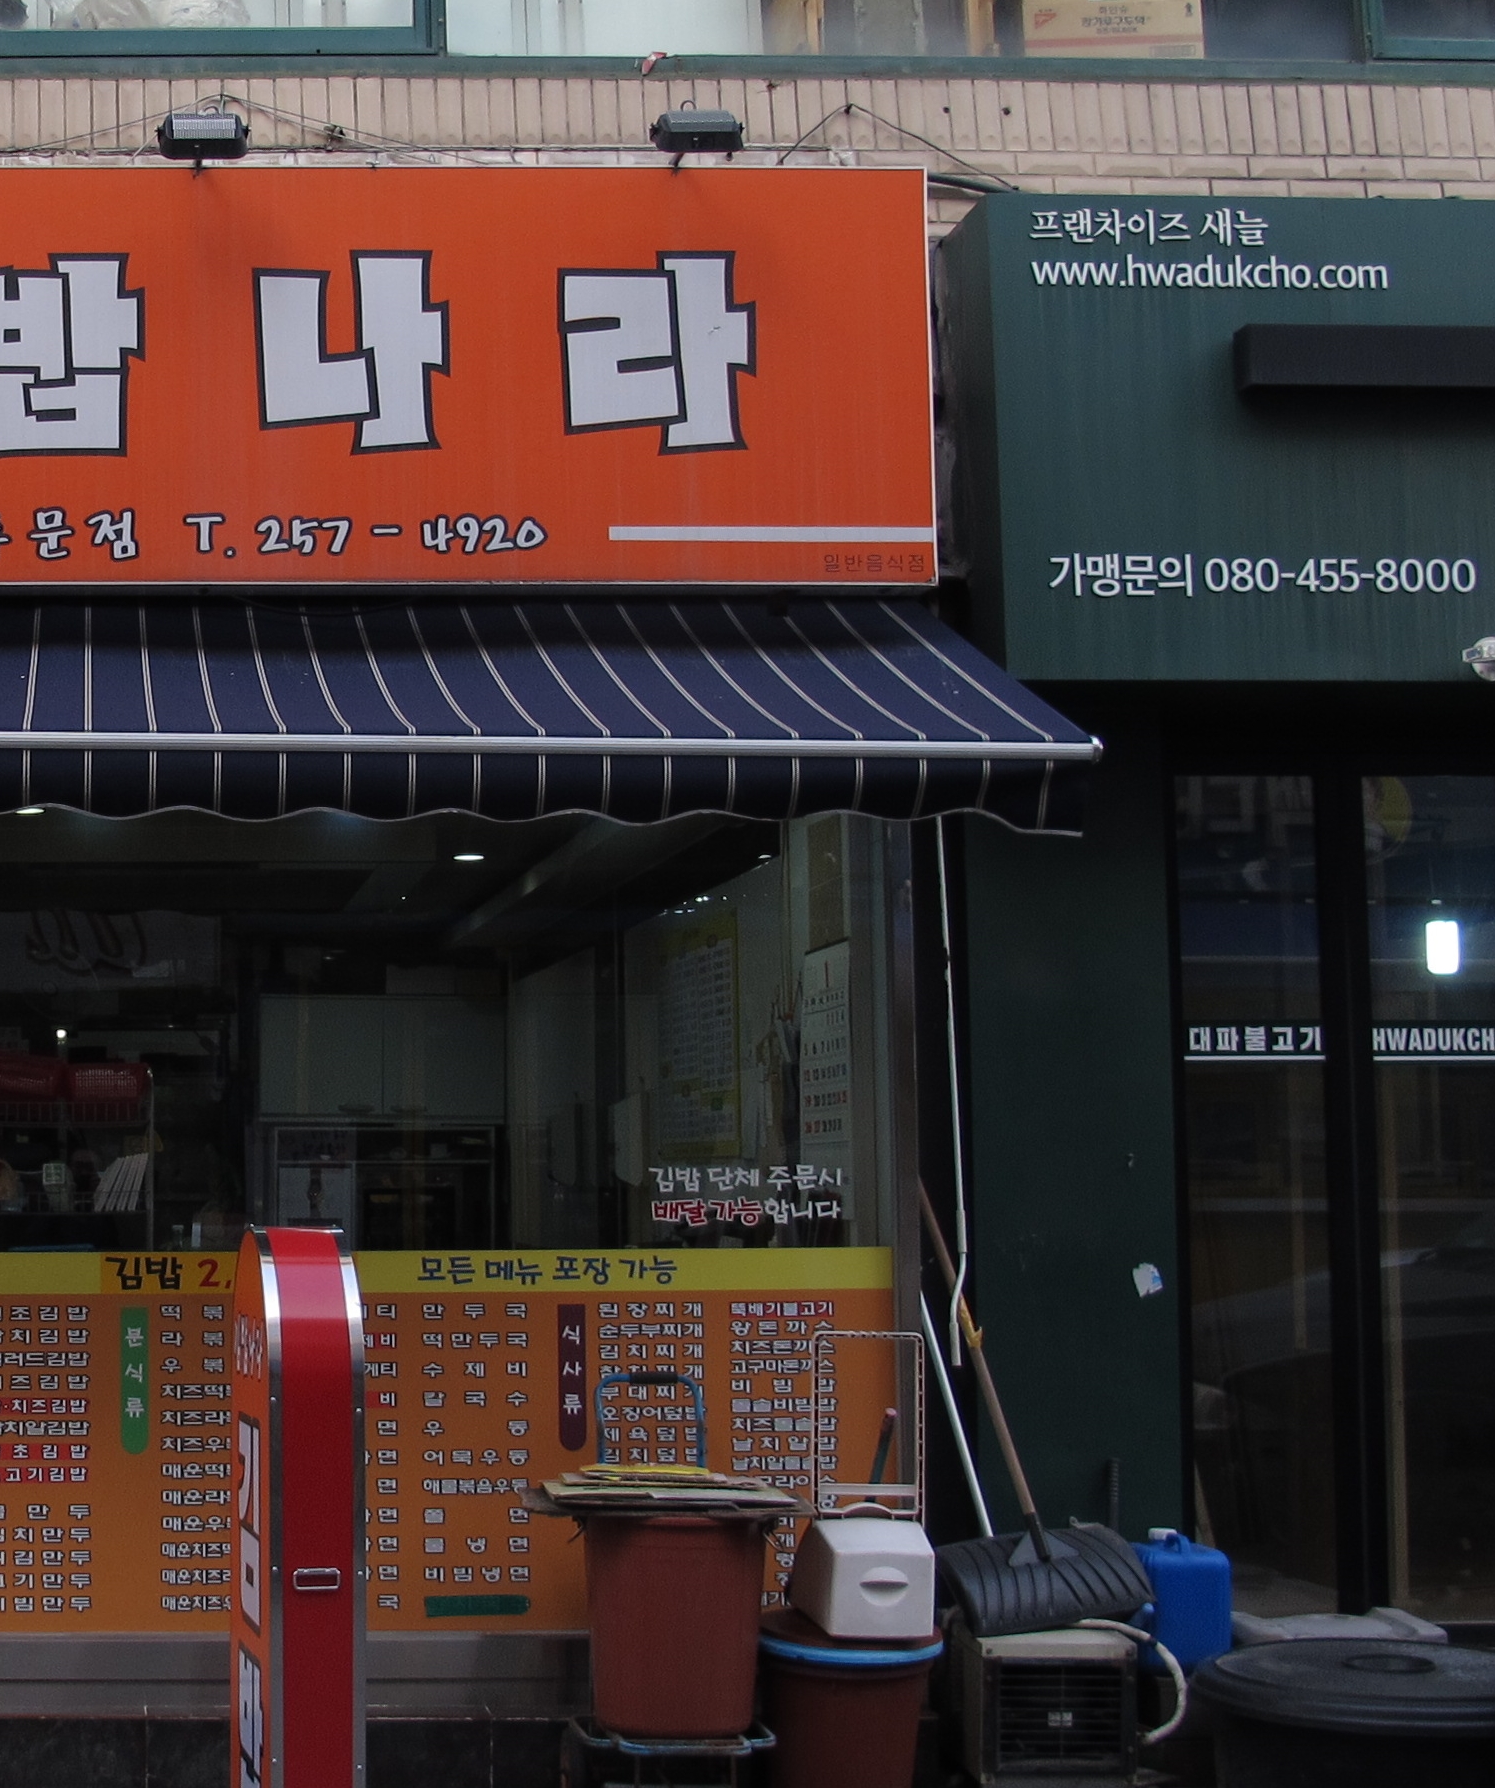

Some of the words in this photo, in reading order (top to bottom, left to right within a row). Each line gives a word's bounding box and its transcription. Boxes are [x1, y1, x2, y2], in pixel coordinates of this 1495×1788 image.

[1029, 208, 1192, 245] 프랜차이즈
[1200, 208, 1269, 247] 새늘
[1031, 255, 1388, 290] www.hwadukcho.com
[823, 552, 925, 574] 일반음식점
[1049, 553, 1194, 597] 가맹문의
[1204, 558, 1477, 594] 080-455-8000
[1188, 1026, 1322, 1052] 대파불고기
[648, 1166, 701, 1194] 김밥
[707, 1165, 760, 1192] 단체
[766, 1164, 843, 1189] 주문시
[651, 1199, 707, 1228] 배달
[708, 1195, 842, 1227] 가능합니다
[105, 1256, 183, 1291] 김밥
[417, 1256, 476, 1285] 모든
[484, 1256, 544, 1286] 메뉴
[552, 1255, 611, 1286] 포장
[618, 1254, 678, 1285] 가능
[423, 1303, 527, 1319] 만두국
[599, 1303, 703, 1318] 된장찌개
[423, 1333, 527, 1349] 떡만두국
[599, 1323, 703, 1339] 순두부찌개
[599, 1344, 703, 1359] 김치찌개
[124, 1327, 146, 1418] 분식류
[423, 1362, 527, 1378] 수제비
[561, 1323, 583, 1415] 식사류
[423, 1391, 527, 1407] 칼국수
[423, 1449, 527, 1465] 어묵우동
[424, 1566, 529, 1583] 비빔냉면
